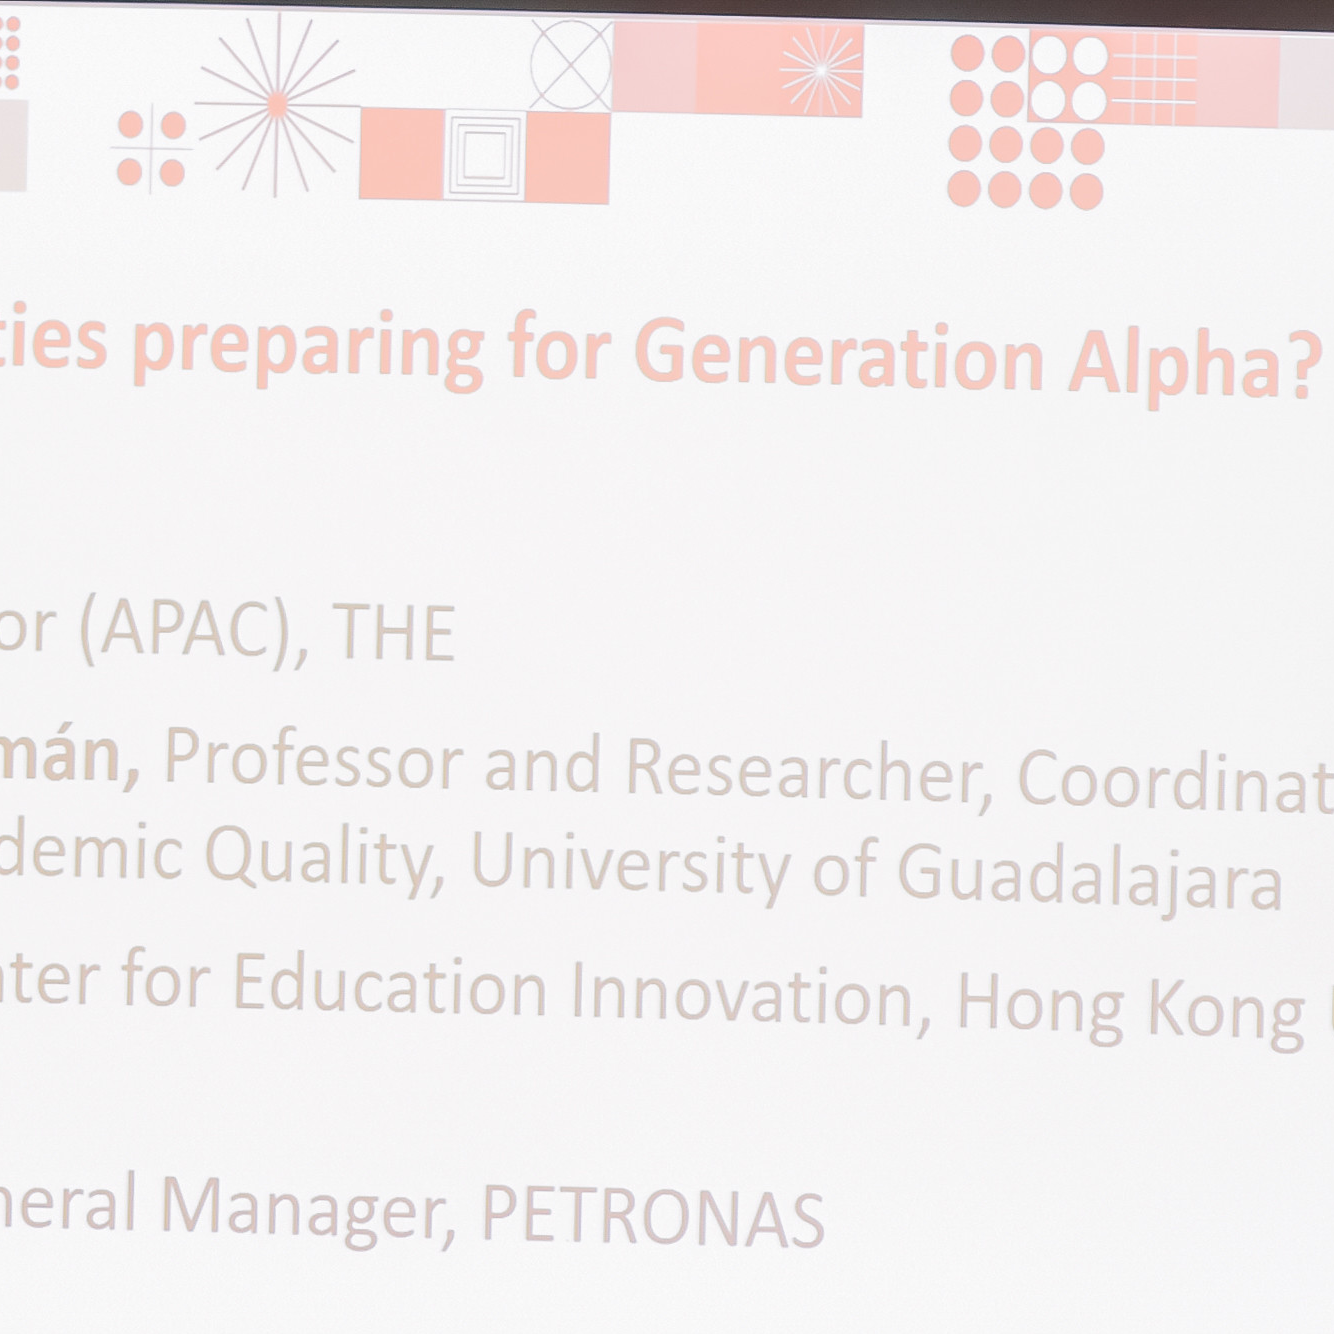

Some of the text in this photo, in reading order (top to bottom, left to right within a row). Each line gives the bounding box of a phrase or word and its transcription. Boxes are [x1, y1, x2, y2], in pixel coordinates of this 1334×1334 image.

[134, 309, 484, 394] preparing
[508, 309, 611, 380] for
[635, 317, 1042, 390] Generation
[1068, 325, 1322, 412] Alpha?
[81, 592, 307, 672] (APAC),
[332, 603, 455, 661] THE
[167, 725, 464, 789] Professor
[486, 733, 599, 792] and
[629, 738, 991, 816] Researcher,
[206, 823, 443, 900] Quality,
[474, 831, 791, 909] University
[814, 836, 879, 897] of
[899, 842, 1281, 921] Guadalajara
[121, 946, 211, 1007] for
[236, 950, 545, 1016] Education
[574, 961, 930, 1040] Innovation,
[960, 972, 1124, 1047] Hong
[1150, 979, 1305, 1054] Kong
[163, 1176, 455, 1252] Manager,
[484, 1184, 824, 1248] PETRONAS
